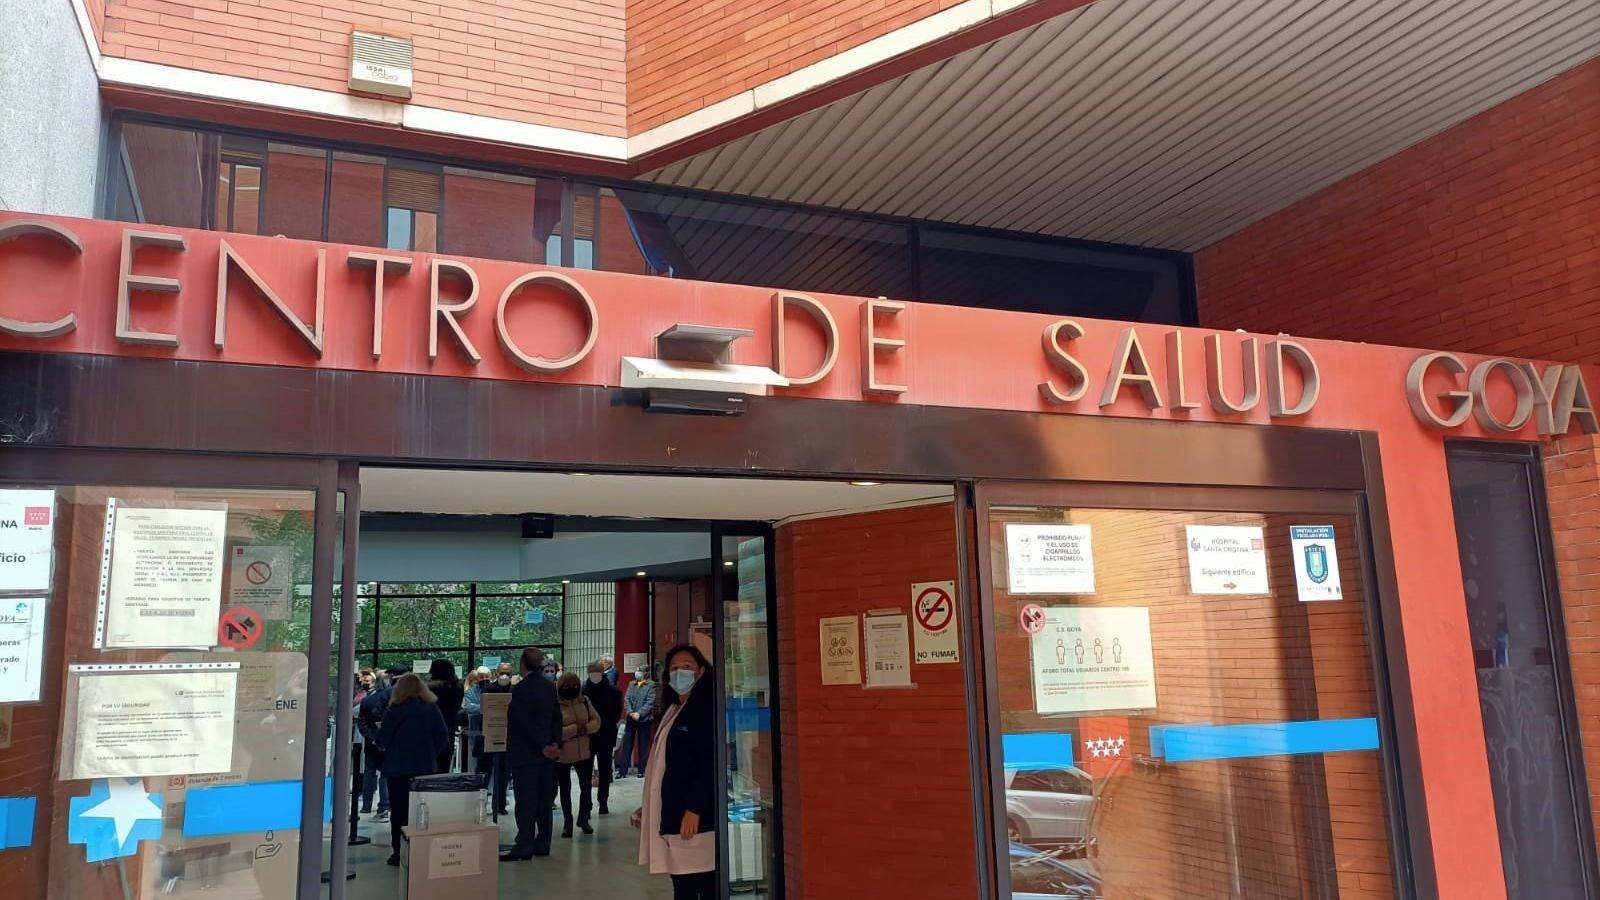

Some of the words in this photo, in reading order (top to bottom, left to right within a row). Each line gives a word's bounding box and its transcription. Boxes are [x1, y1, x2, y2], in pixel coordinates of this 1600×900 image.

[0, 219, 598, 374] CENTRO
[771, 291, 908, 395] DE
[1038, 319, 1322, 418] SALUD
[1406, 352, 1600, 435] GOYA
[931, 650, 956, 658] FUMAR
[275, 699, 297, 711] ENE
